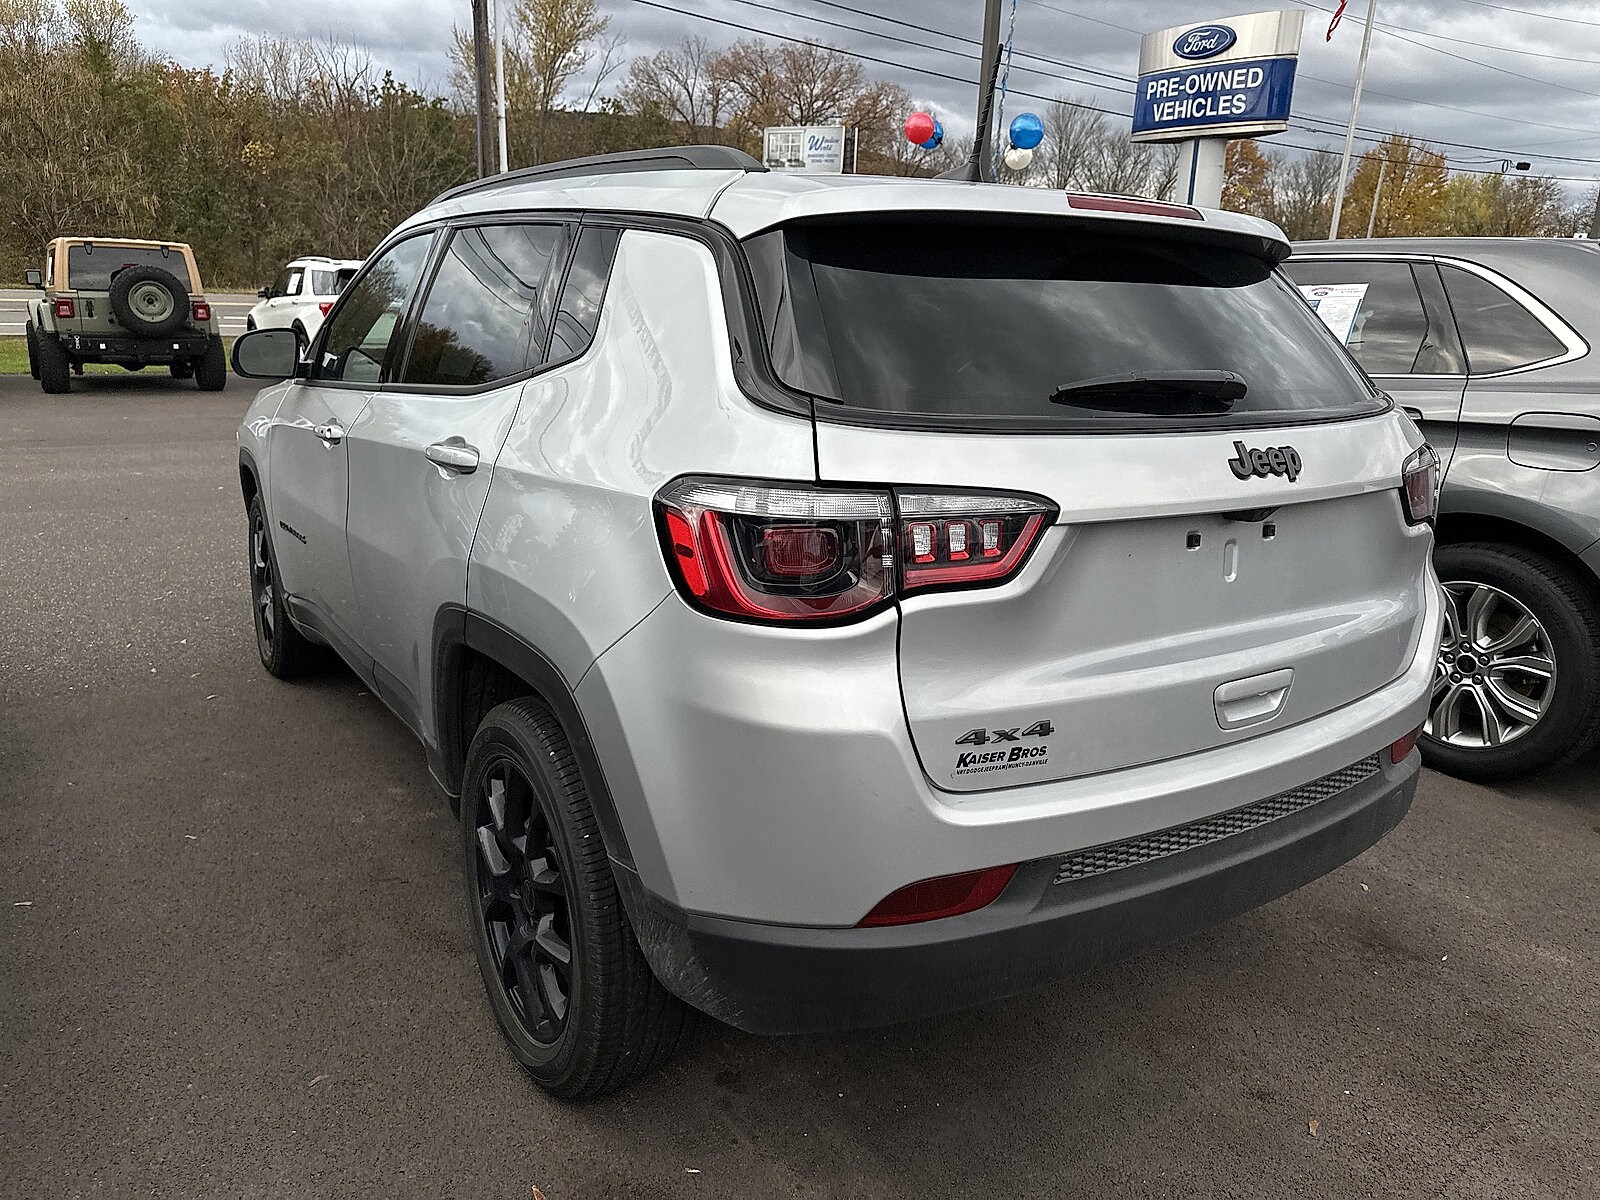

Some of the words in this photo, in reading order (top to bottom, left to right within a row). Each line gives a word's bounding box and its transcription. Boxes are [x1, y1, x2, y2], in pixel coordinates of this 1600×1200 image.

[1183, 30, 1220, 54] Ford
[1146, 67, 1264, 101] PRE-OWNED
[1153, 93, 1247, 122] VEHICLES
[1227, 440, 1303, 483] Jeep
[955, 751, 1007, 769] KAISER
